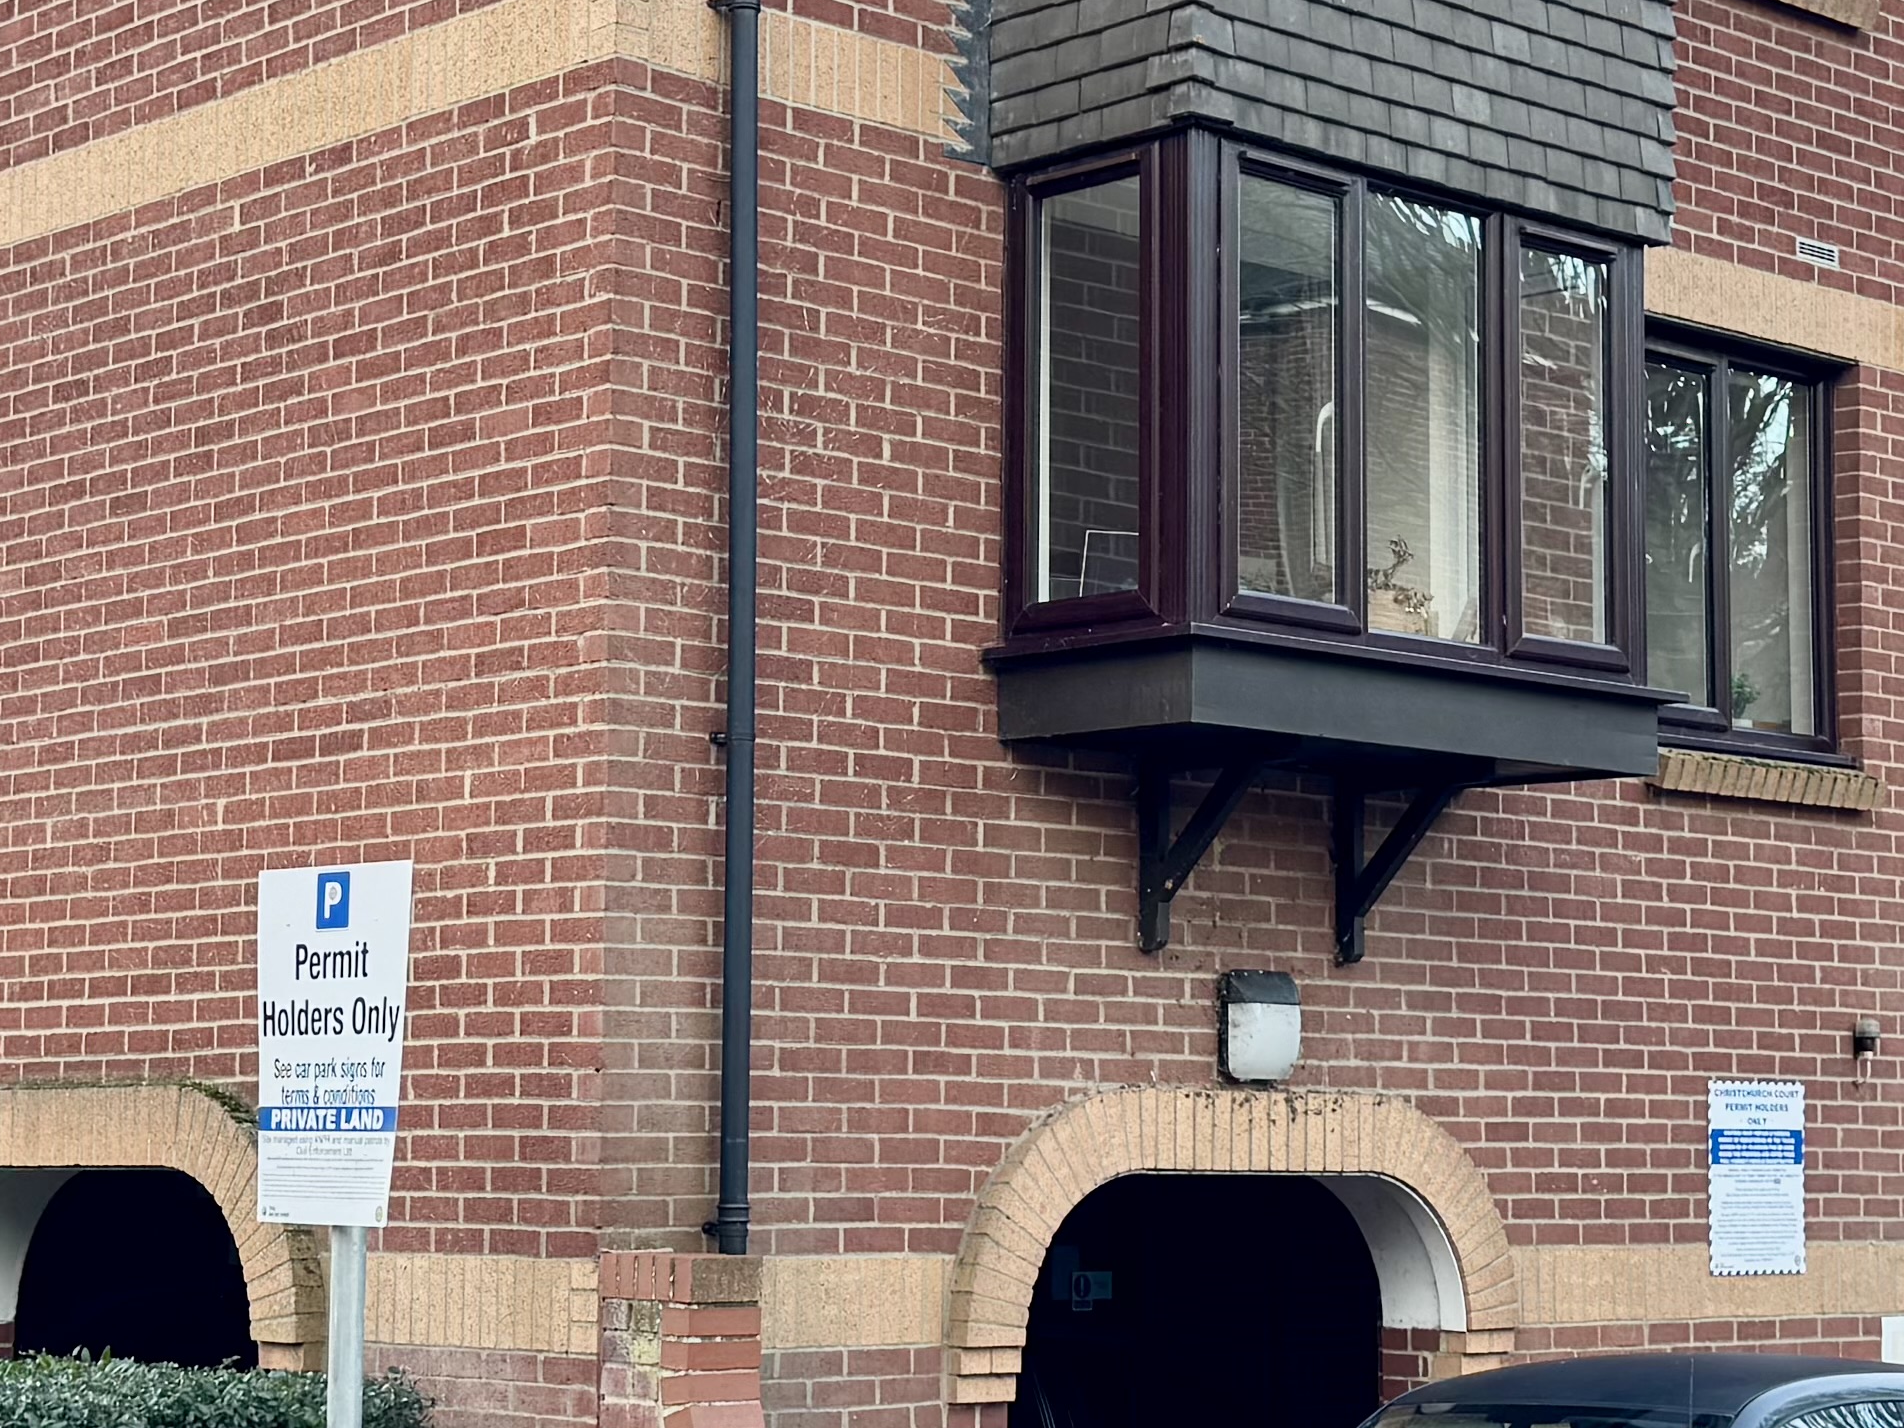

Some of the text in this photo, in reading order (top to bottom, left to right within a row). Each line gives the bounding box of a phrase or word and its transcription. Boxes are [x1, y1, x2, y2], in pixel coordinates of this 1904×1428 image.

[324, 881, 343, 919] P
[295, 941, 369, 981] Permit
[263, 996, 400, 1043] Holders Only
[274, 1057, 385, 1082] See car park signs for
[281, 1084, 376, 1105] terms & conditions
[1714, 1089, 1798, 1098] CHRISTCHURCH COURT
[1725, 1103, 1788, 1112] PERMIT HOLDERS
[271, 1108, 384, 1130] PRIVATE LAND
[1747, 1117, 1767, 1126] ONLY
